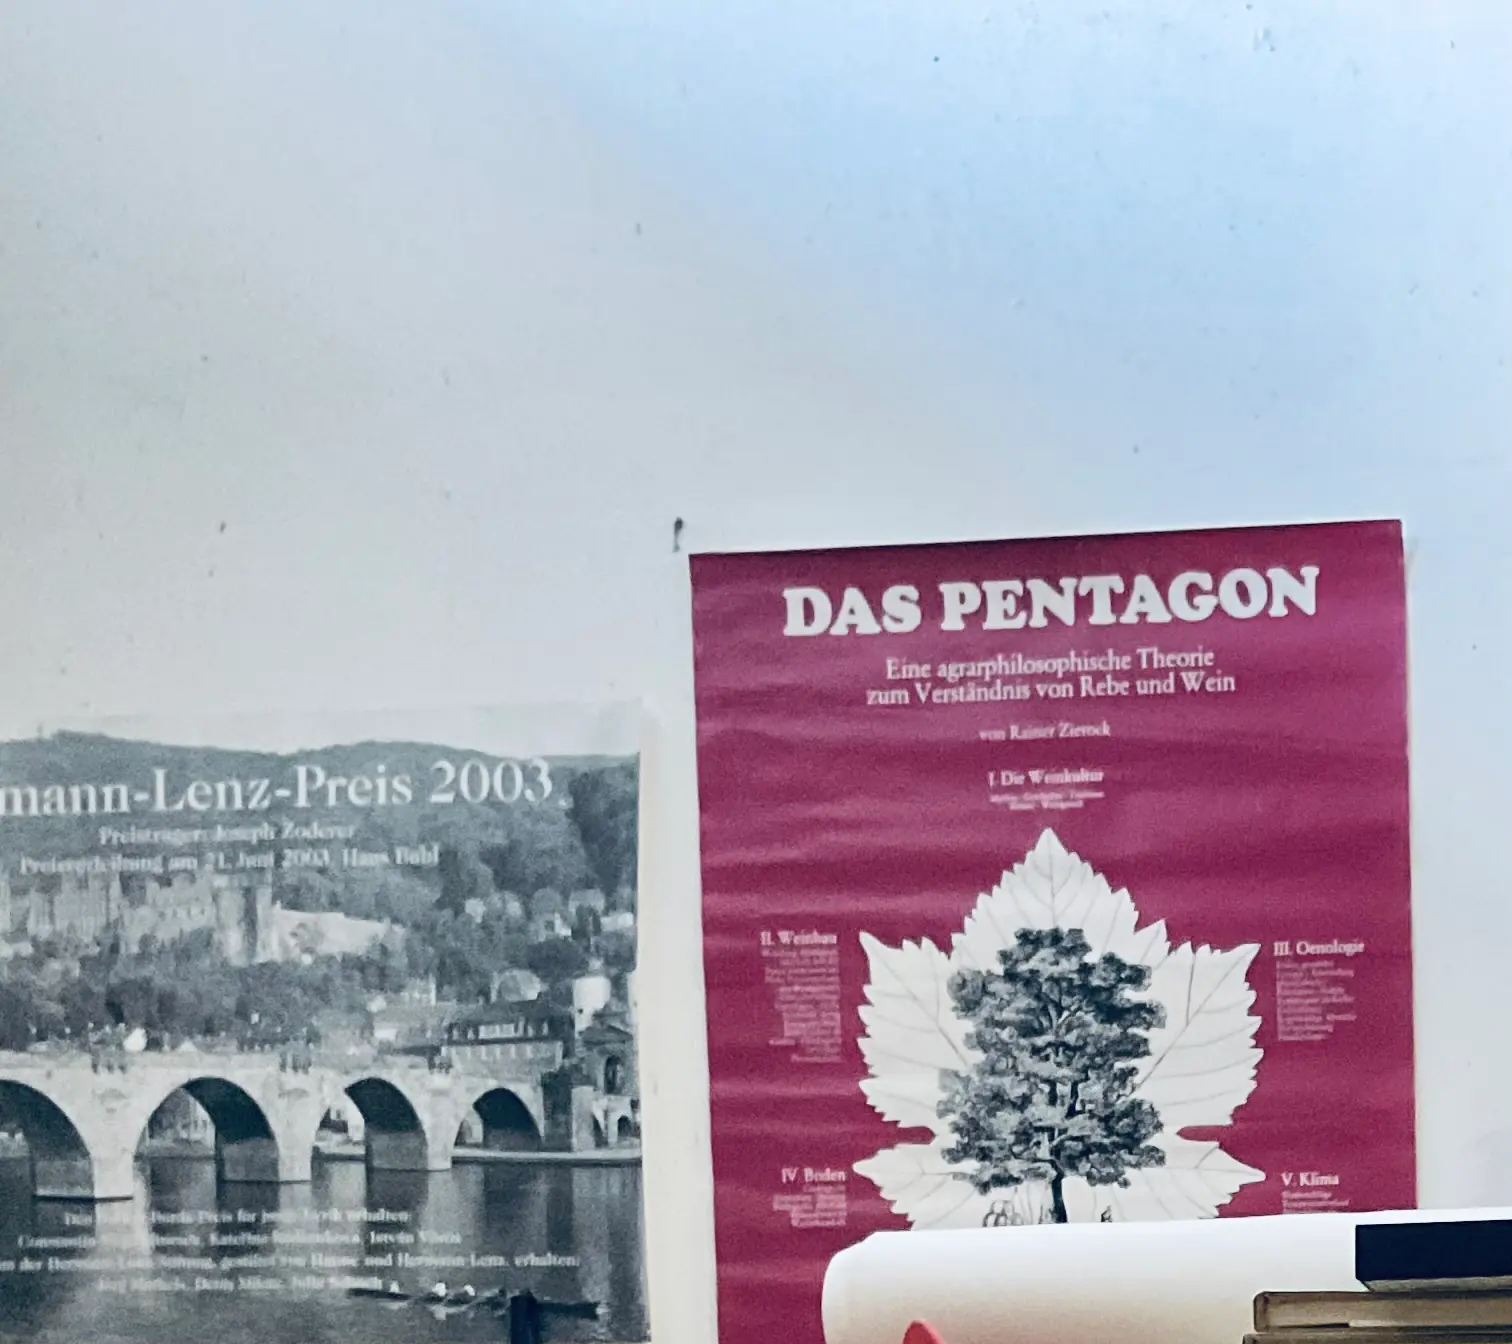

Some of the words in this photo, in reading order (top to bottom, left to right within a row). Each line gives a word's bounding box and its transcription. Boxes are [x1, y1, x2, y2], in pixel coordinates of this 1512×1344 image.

[783, 586, 922, 635] DAS
[940, 566, 1320, 631] PENTAGON
[886, 658, 931, 681] Eine
[937, 650, 1132, 682] agrarphilosophische
[1137, 646, 1215, 669] Theorie
[867, 688, 910, 705] zum
[916, 680, 1031, 704] Verständnis
[1036, 683, 1074, 700] von
[1081, 675, 1130, 698] Rebe
[1137, 672, 1176, 695] und
[1181, 669, 1236, 693] Wein
[1010, 724, 1055, 741] Rainer
[1059, 721, 1111, 739] Zierock
[1001, 770, 1025, 786] Die
[1028, 768, 1104, 784] Weinkultur
[0, 762, 414, 816] mann-Lenz-Preis
[777, 929, 838, 945] Weinbau
[1296, 939, 1365, 957] Oenologie
[803, 1167, 846, 1182] Boden
[1299, 1171, 1340, 1187] Klima
